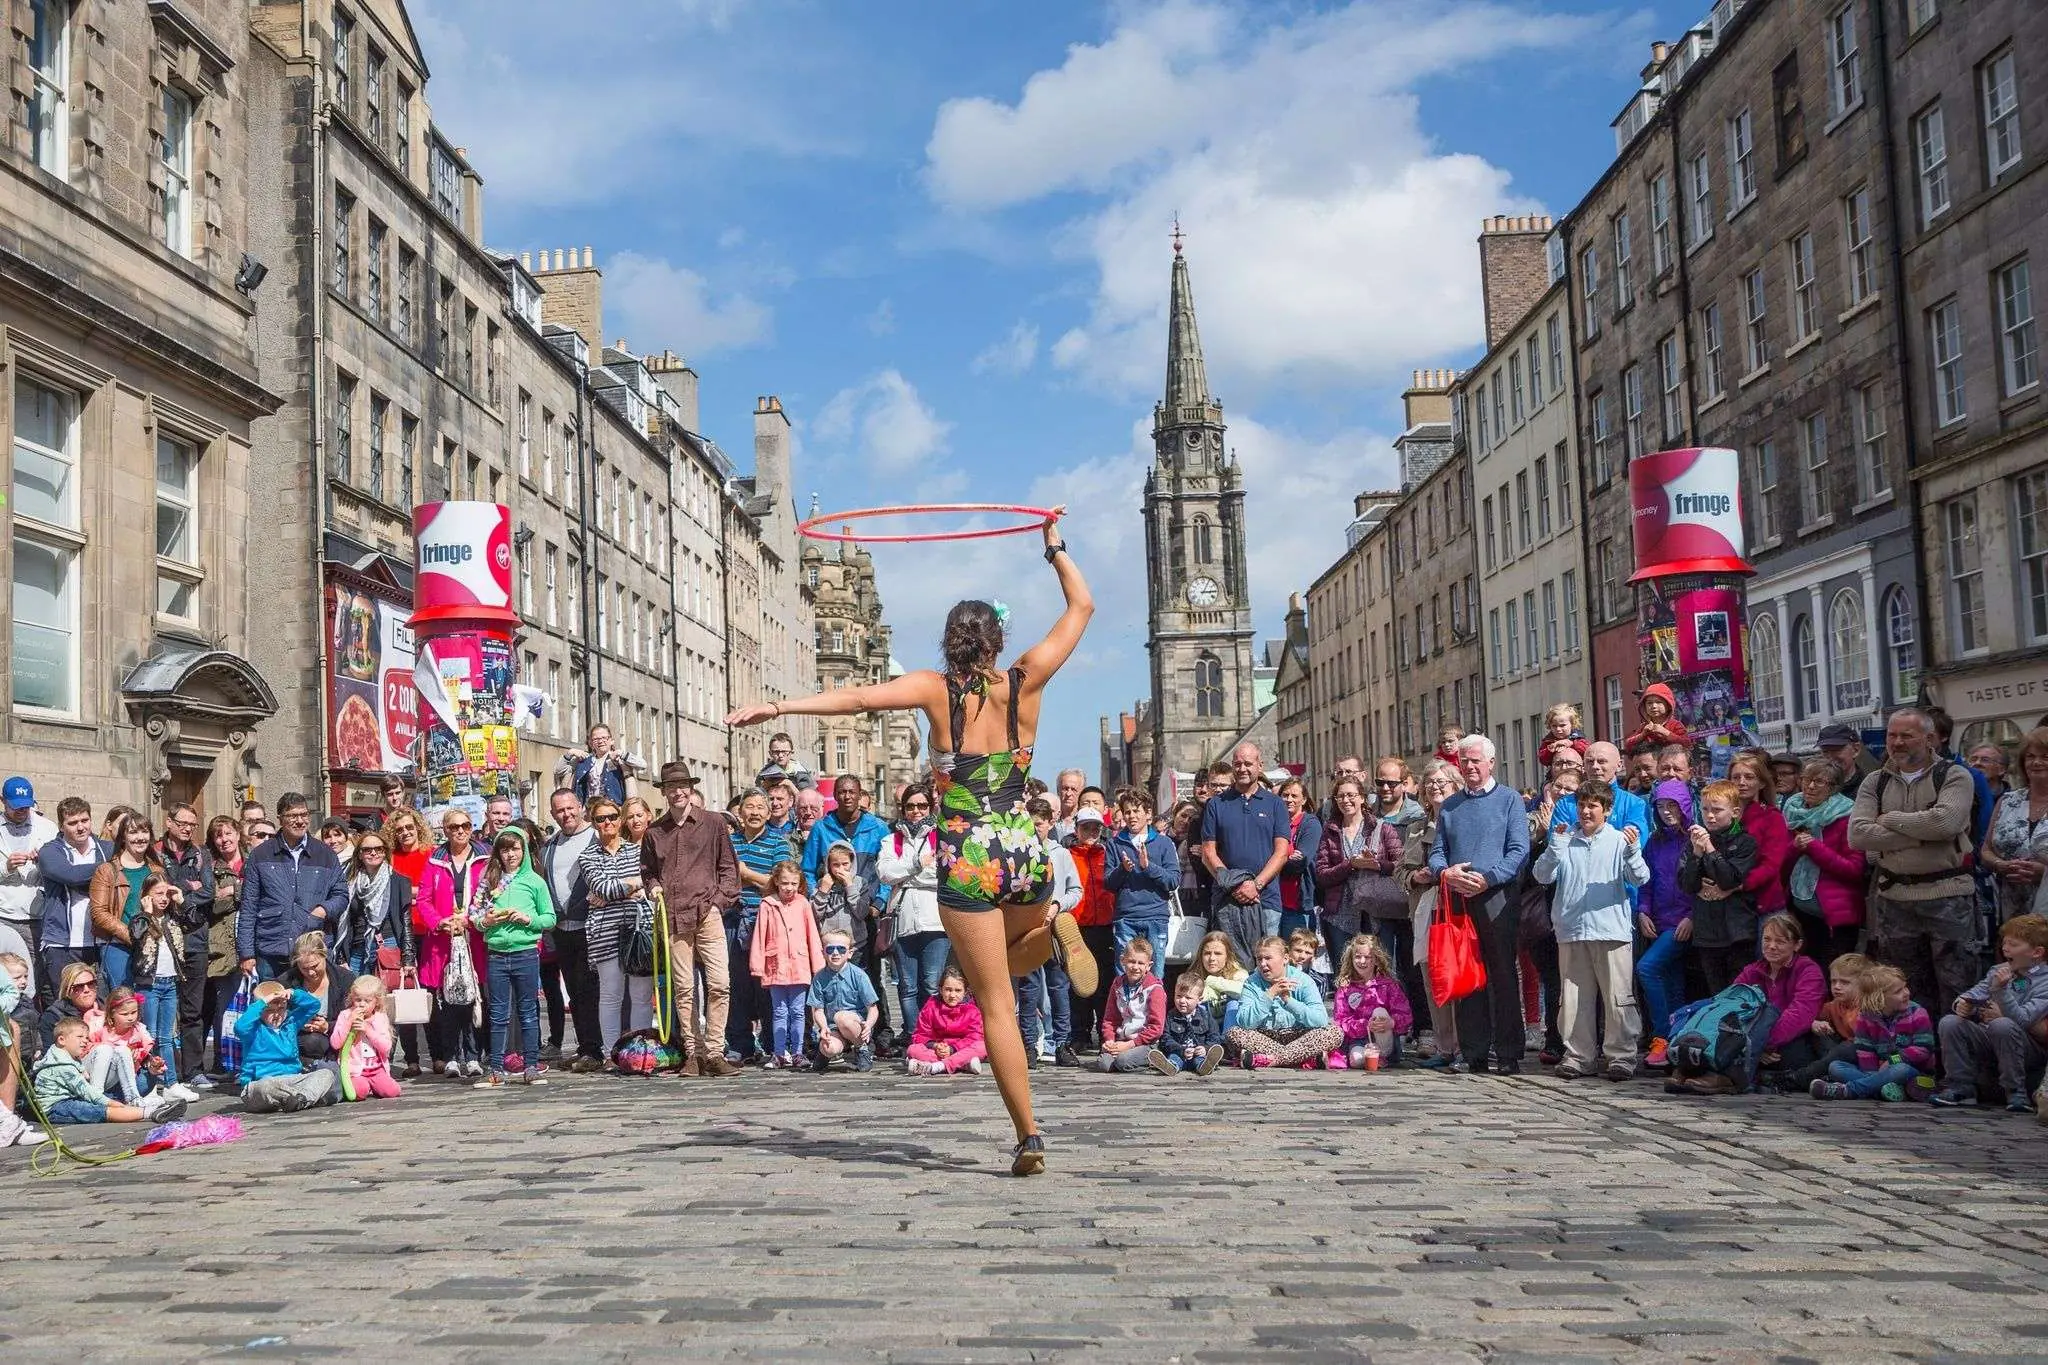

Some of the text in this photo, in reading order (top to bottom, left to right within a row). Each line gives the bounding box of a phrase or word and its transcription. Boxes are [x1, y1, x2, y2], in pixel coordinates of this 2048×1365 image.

[1635, 505, 1658, 517] money
[1675, 493, 1730, 516] fringe
[423, 543, 472, 565] fringe
[389, 683, 397, 711] 2
[1966, 685, 2012, 703] TASTE
[2017, 681, 2037, 696] OF
